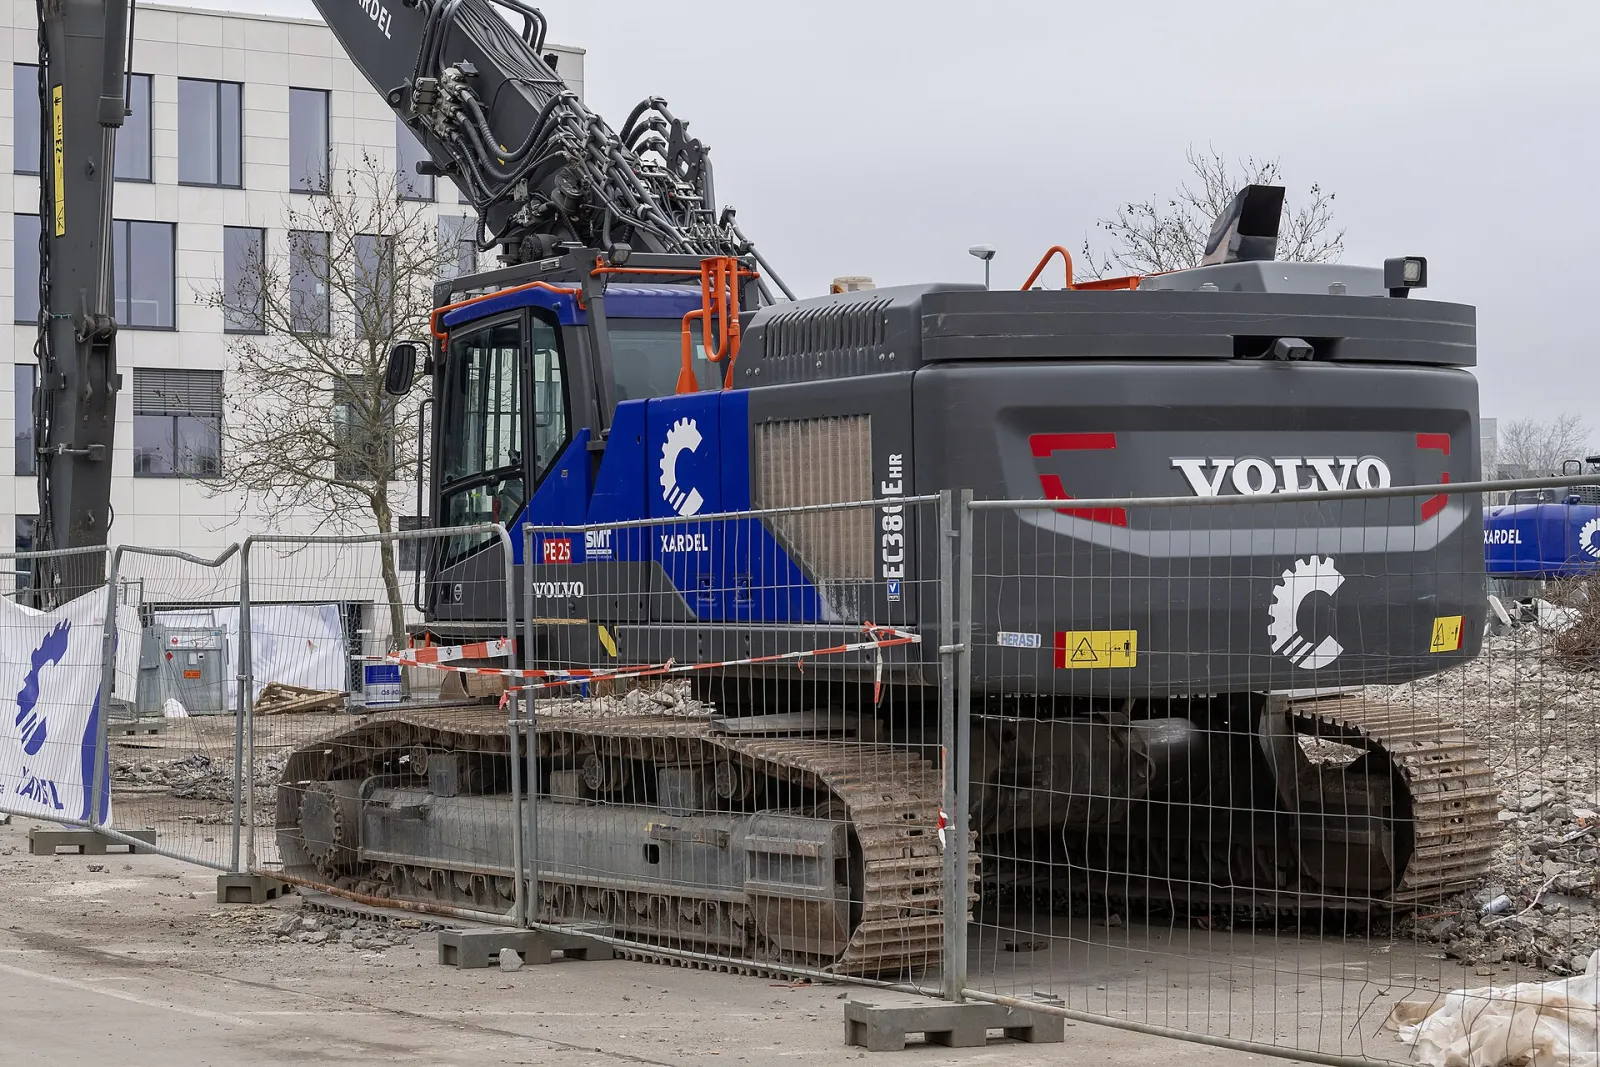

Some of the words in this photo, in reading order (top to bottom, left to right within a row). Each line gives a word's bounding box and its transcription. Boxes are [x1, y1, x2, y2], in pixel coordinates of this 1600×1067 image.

[358, 0, 392, 40] RDEL
[55, 139, 63, 154] 23
[1169, 455, 1392, 497] VOLVO
[585, 529, 612, 548] SMT
[660, 533, 709, 553] XARDEL
[1483, 529, 1522, 544] XARDEL
[543, 542, 557, 561] PE
[558, 542, 571, 561] 25
[532, 581, 584, 599] VOLVO
